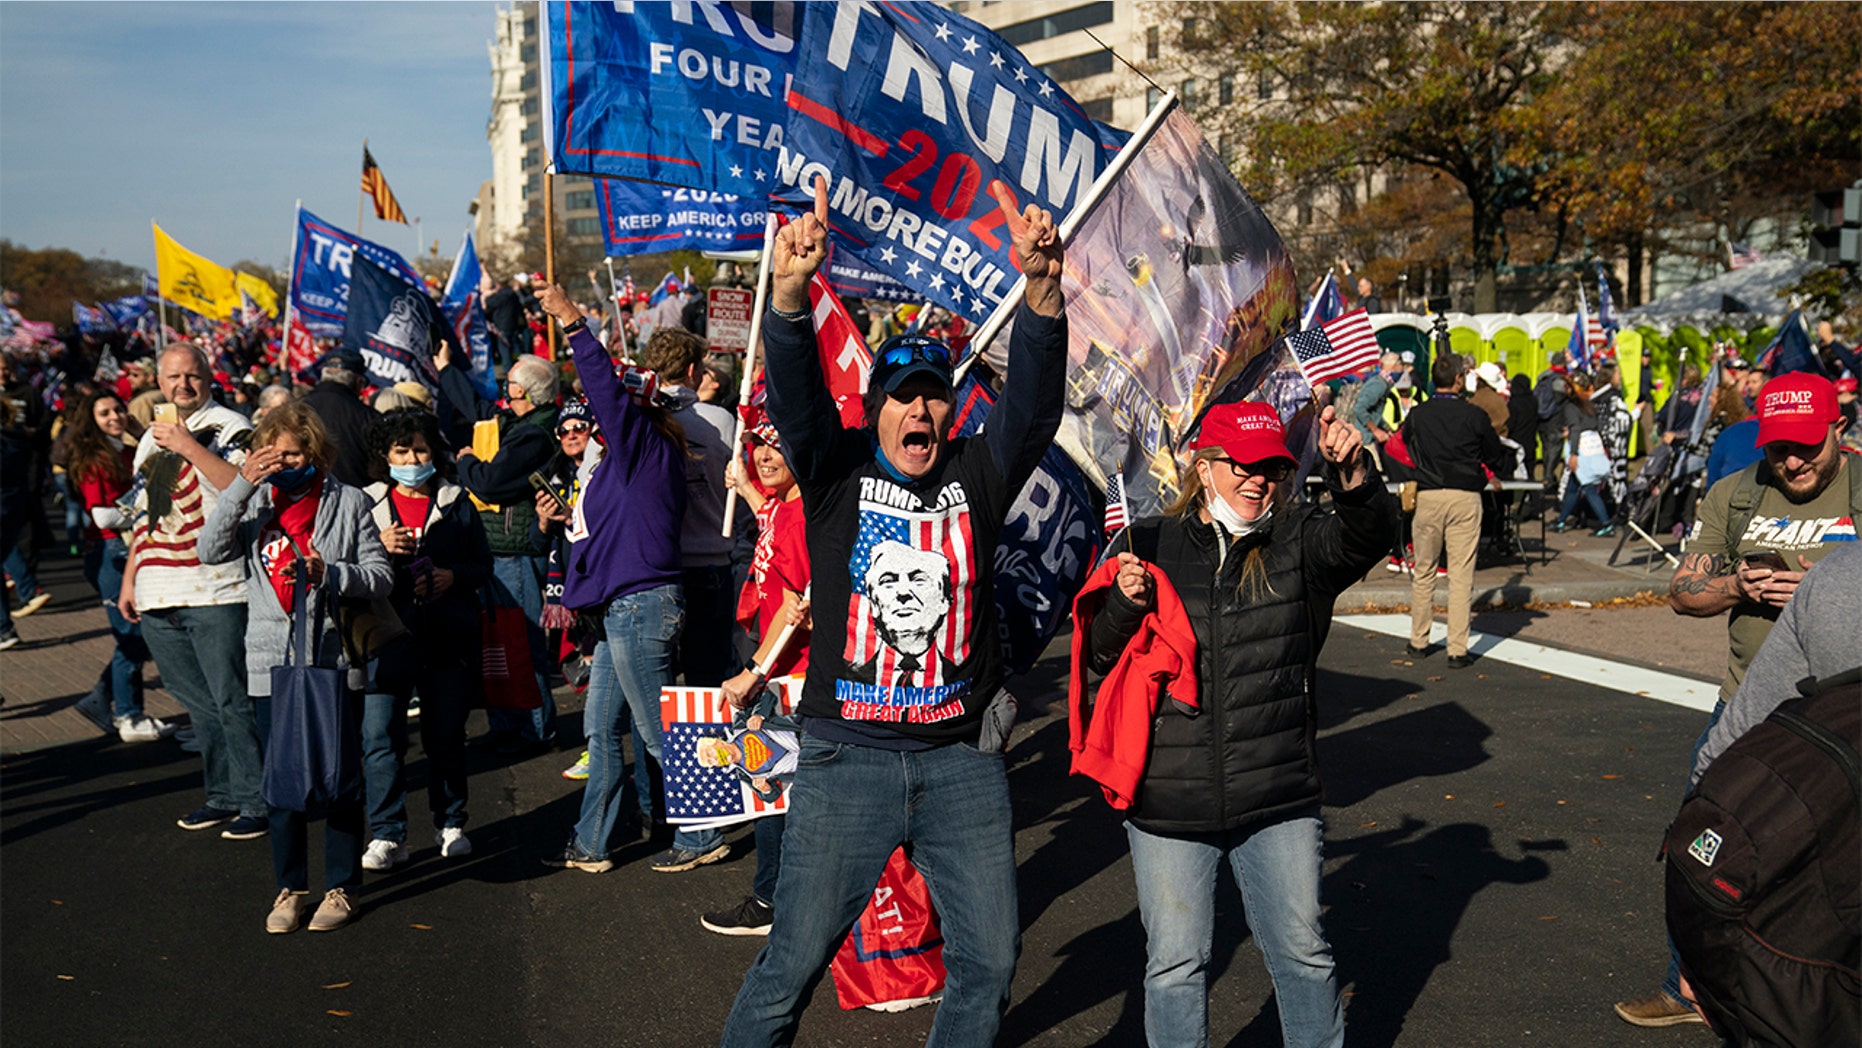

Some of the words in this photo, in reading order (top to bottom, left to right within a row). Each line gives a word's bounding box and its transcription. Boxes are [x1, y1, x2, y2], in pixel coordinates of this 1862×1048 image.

[650, 41, 772, 98] FOUR
[882, 128, 1024, 274] 202
[618, 214, 663, 230] KEEP
[667, 211, 737, 228] AMERICA
[740, 212, 768, 226] GR
[830, 264, 861, 280] MAKE
[861, 271, 901, 285] AMER
[716, 291, 745, 302] SNOW
[713, 308, 746, 320] ROUTE
[1105, 362, 1159, 434] TRUMP
[1765, 390, 1813, 407] TRUMP
[1236, 415, 1257, 424] MAKE
[1240, 422, 1264, 431] GREAT
[860, 476, 923, 511] RUMP
[1755, 540, 1795, 551] AMERICAN
[1797, 541, 1825, 550] PATRIOT
[835, 678, 890, 706] MAKE
[841, 700, 905, 723] GREAT
[907, 699, 965, 724] AGAIN
[1690, 845, 1711, 863] MLS
[874, 873, 903, 936] AT!
